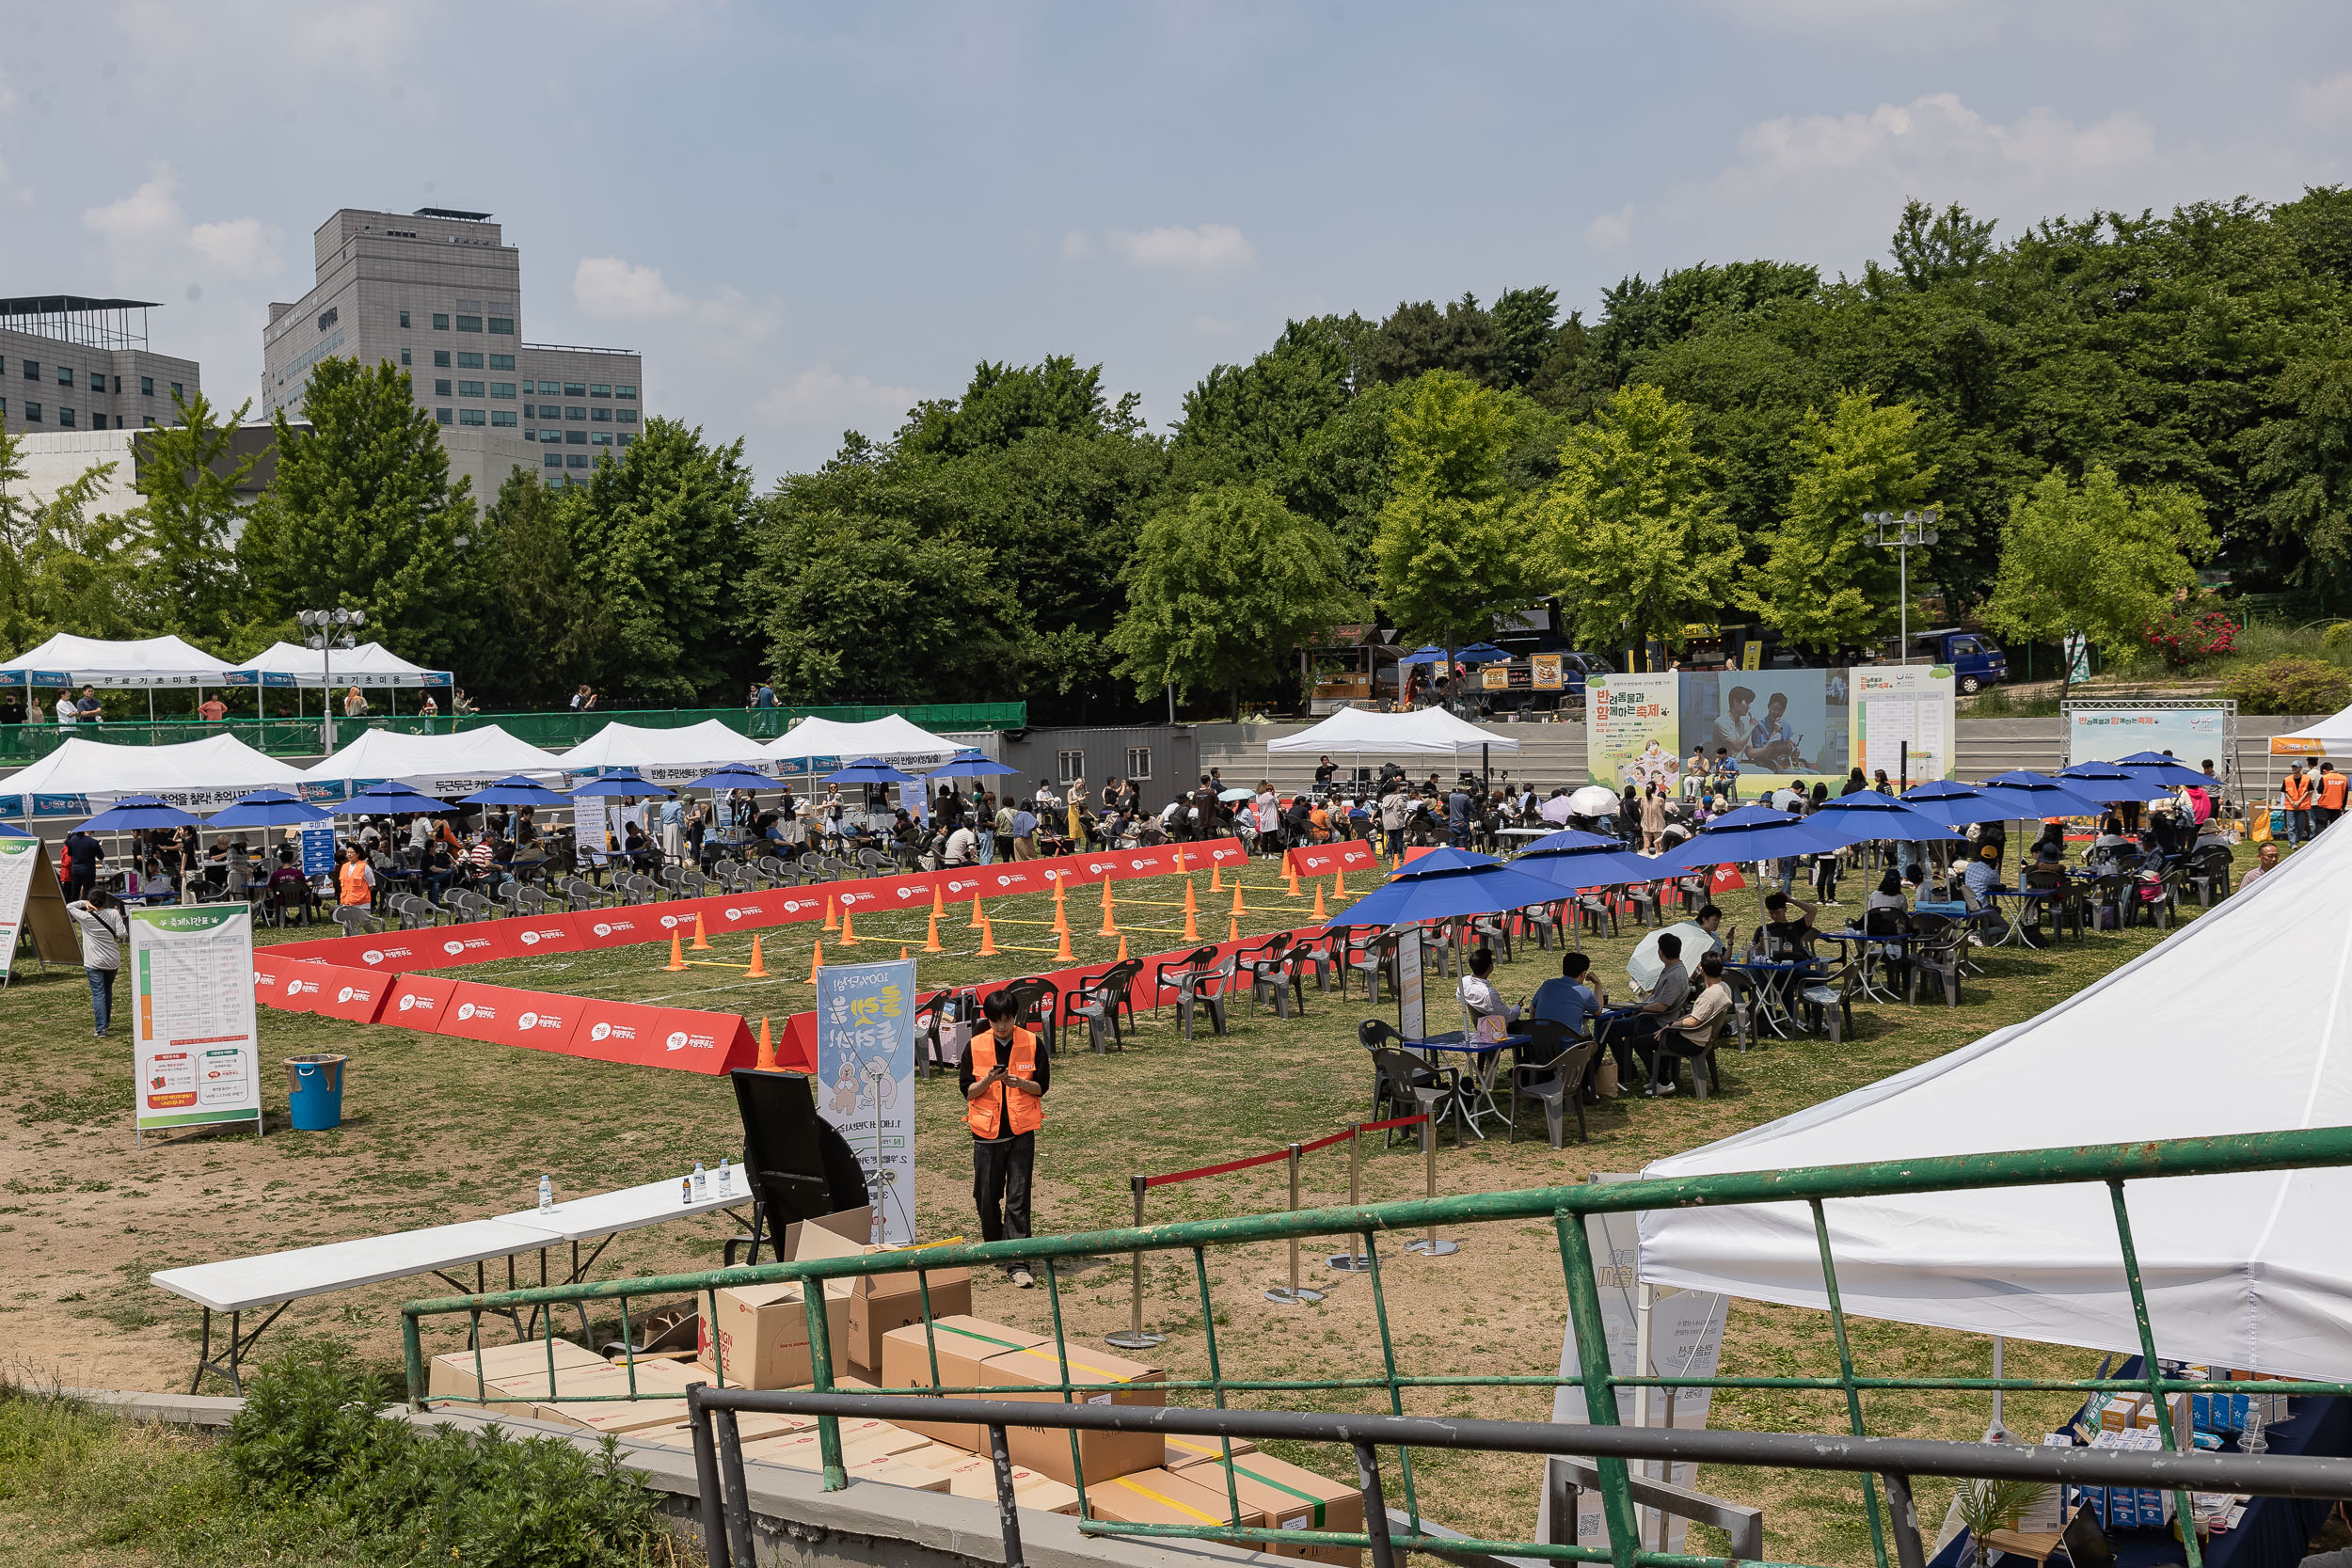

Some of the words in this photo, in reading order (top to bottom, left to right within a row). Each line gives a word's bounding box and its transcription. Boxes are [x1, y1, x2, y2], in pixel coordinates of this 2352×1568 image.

[1597, 689, 1645, 705] 반려동물과
[1636, 704, 1660, 719] 축제
[651, 768, 666, 780] 반함
[667, 767, 698, 779] 주민센터:
[435, 781, 472, 792] 두근두근
[612, 1030, 636, 1040] 하림펫푸드
[672, 1036, 684, 1046] 하림
[689, 1038, 715, 1049] 하림펫푸드
[709, 1323, 734, 1348] DSIGN
[709, 1336, 730, 1356] HPPY
